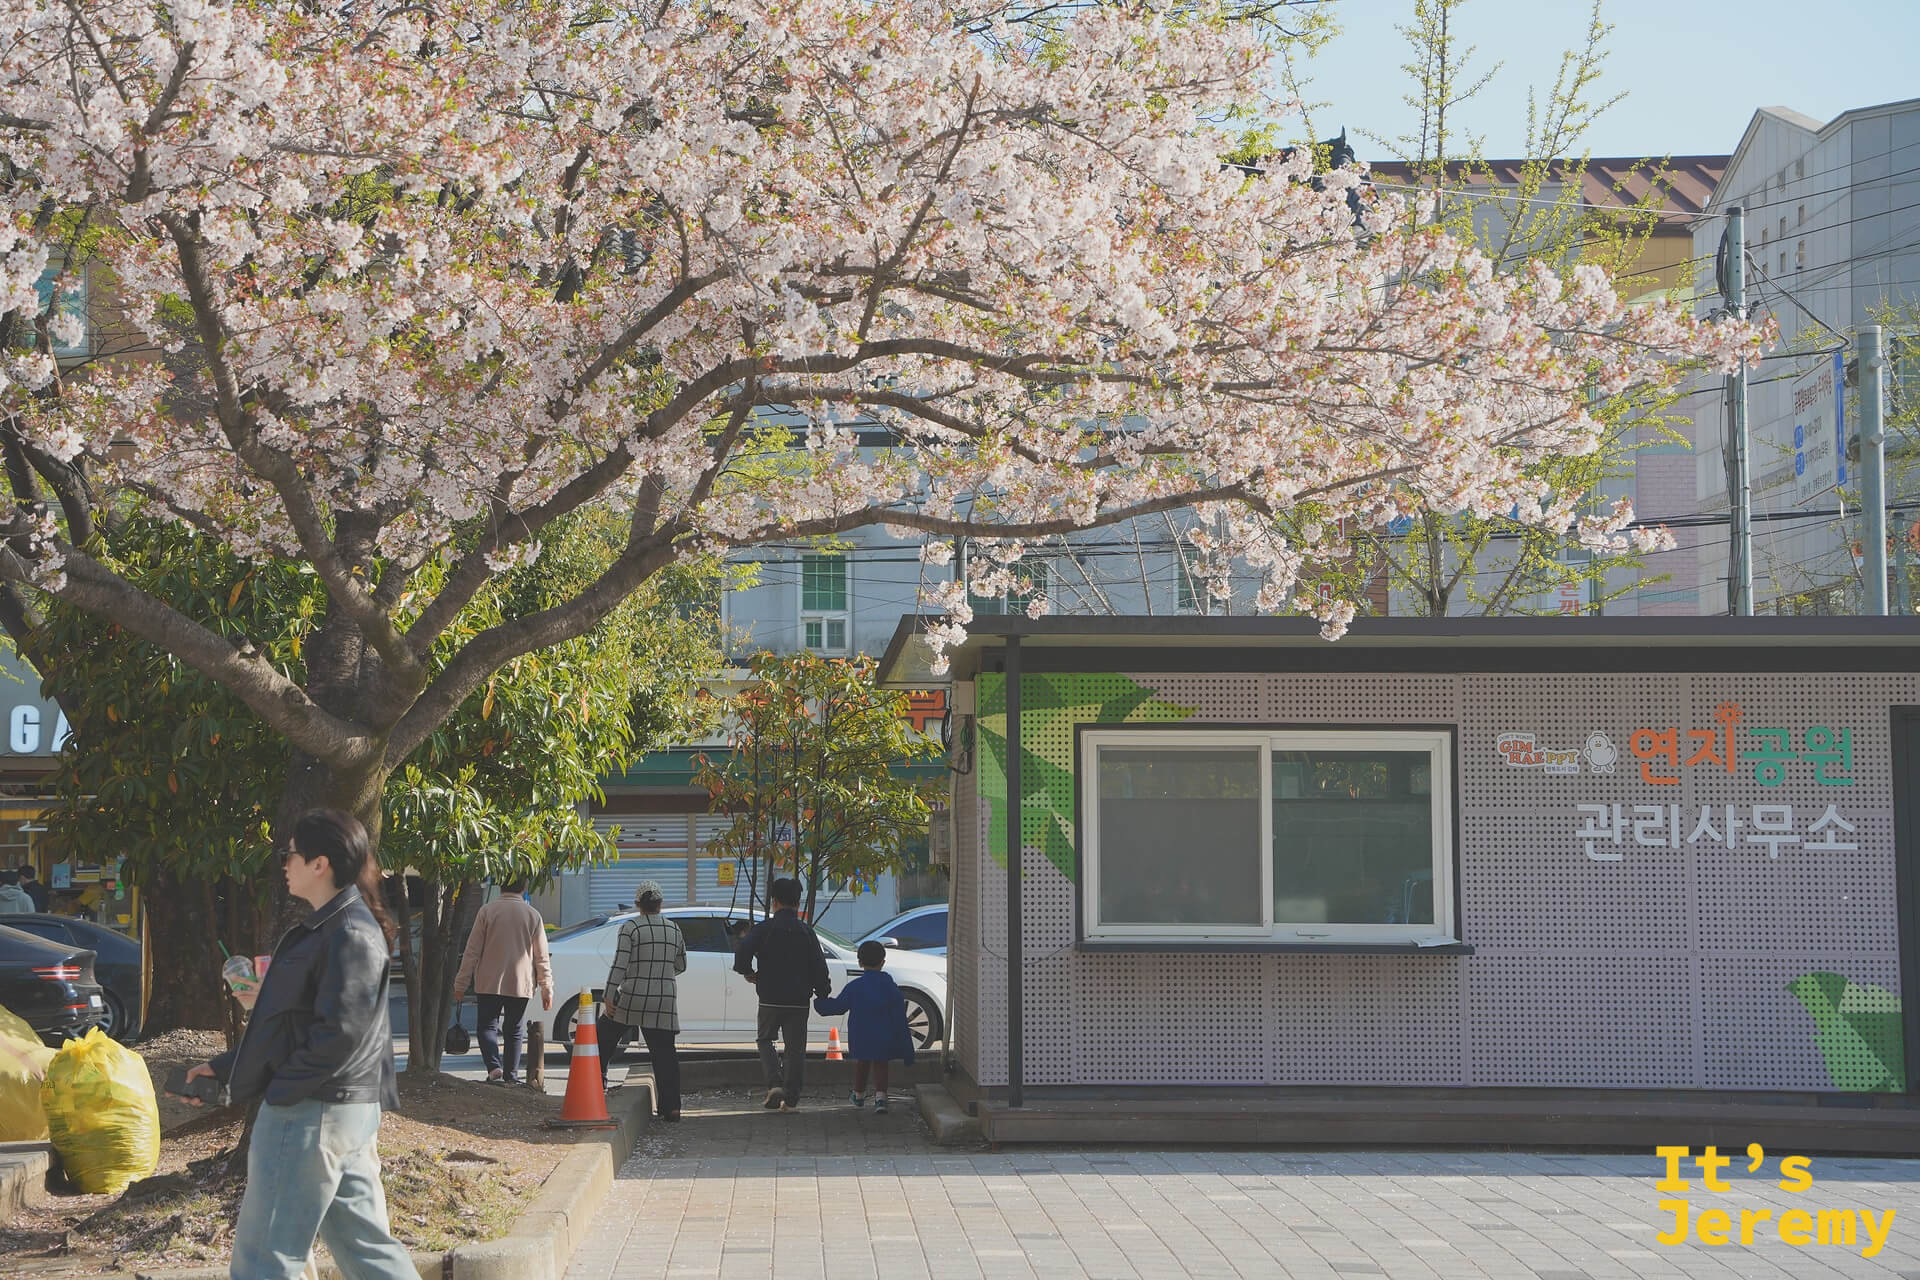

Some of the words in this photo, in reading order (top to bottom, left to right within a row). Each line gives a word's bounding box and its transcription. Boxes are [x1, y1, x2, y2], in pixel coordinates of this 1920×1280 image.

[1500, 740, 1533, 753] GIM
[1630, 703, 1854, 786] 연지공원
[1576, 804, 1858, 861] 관리사무소
